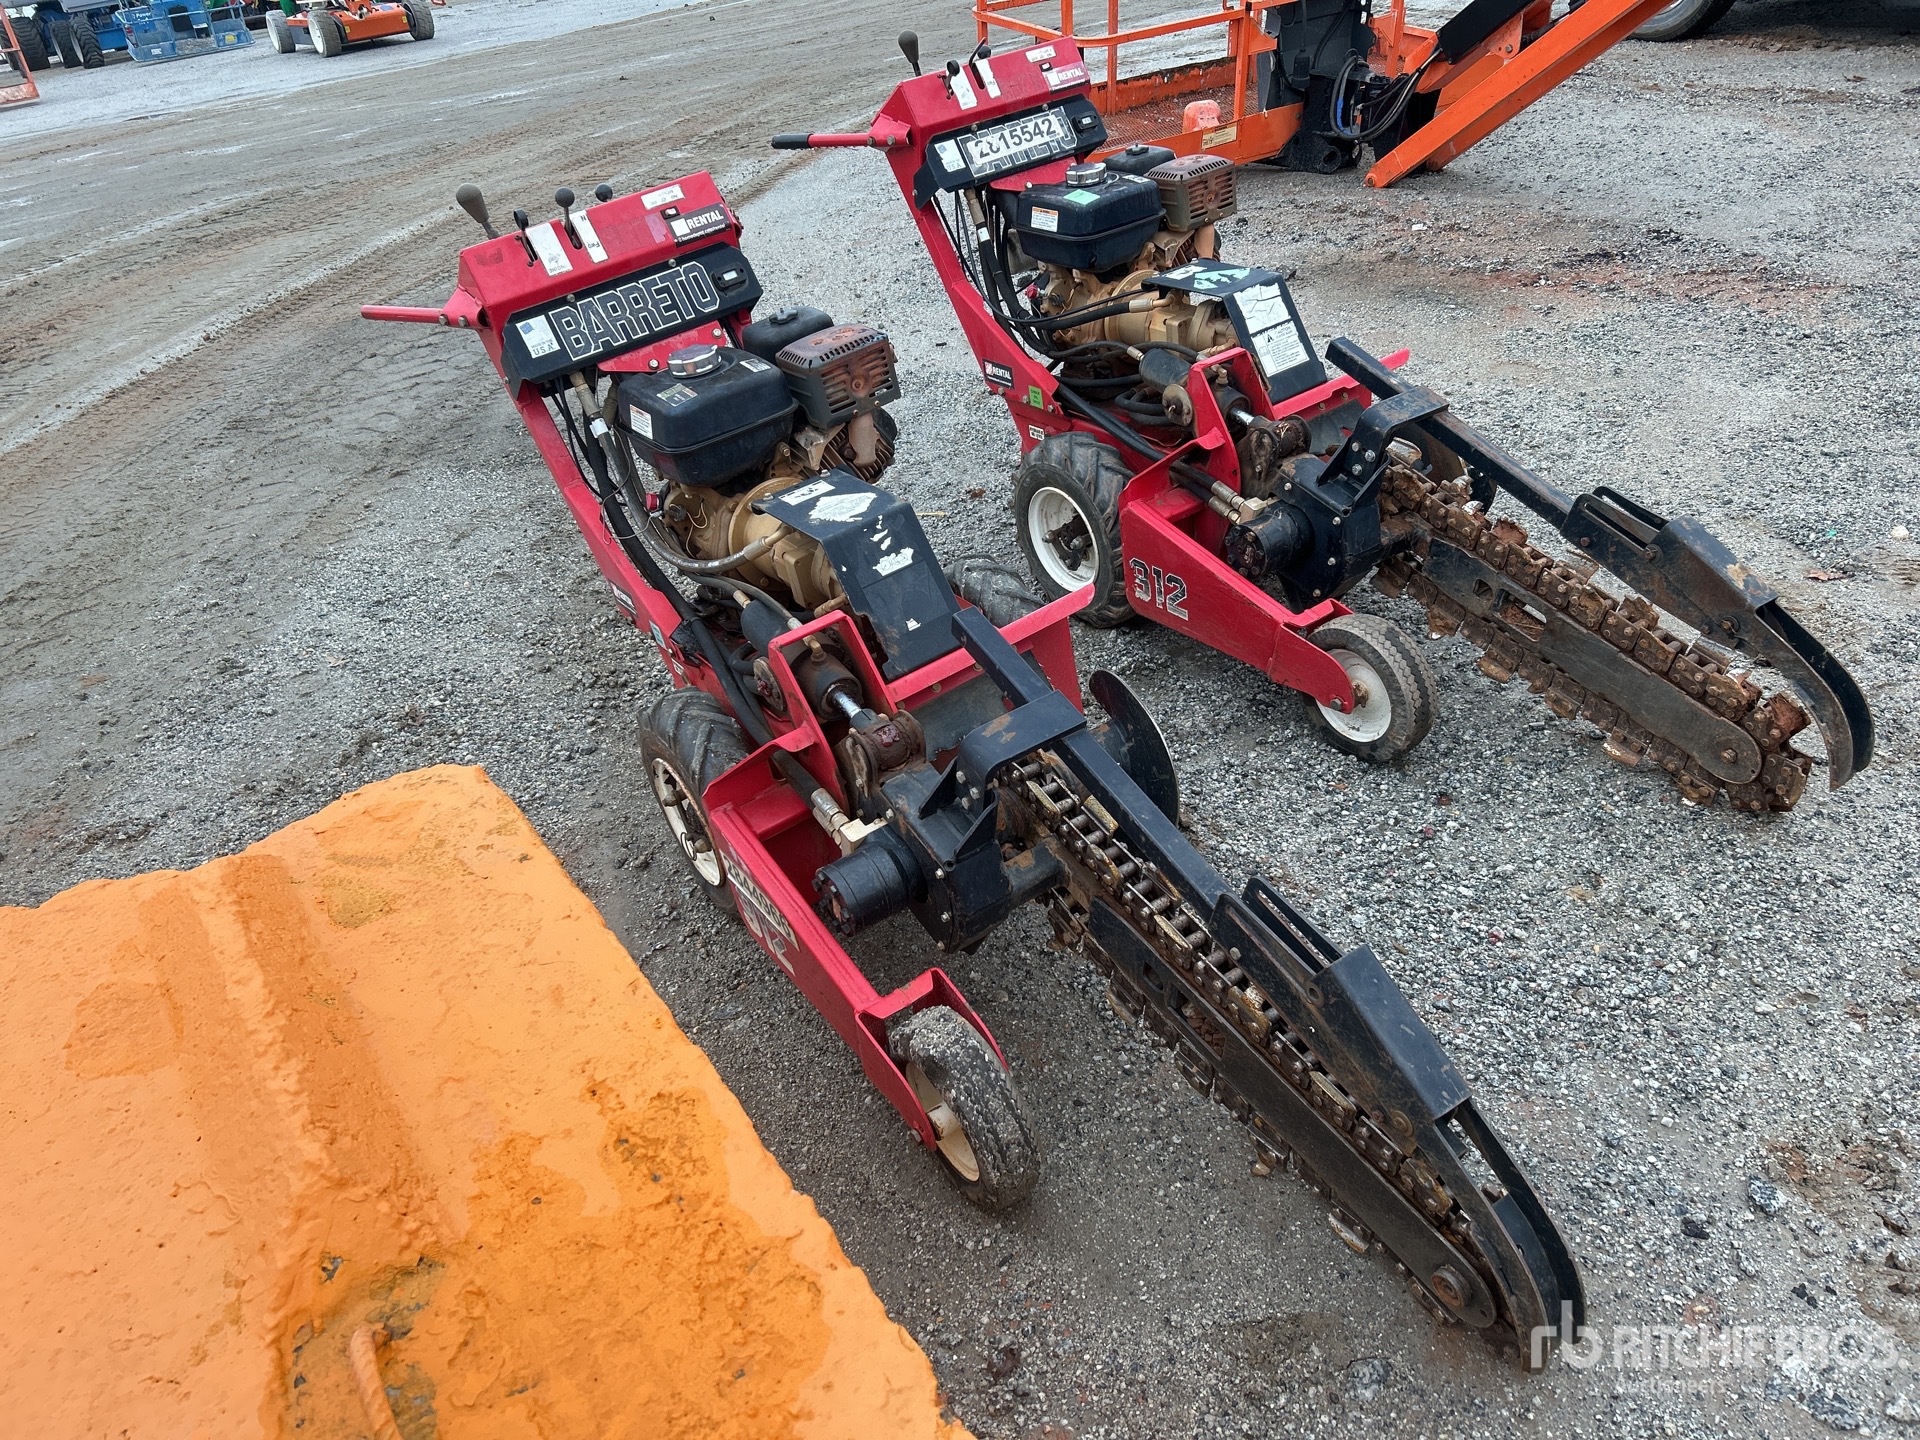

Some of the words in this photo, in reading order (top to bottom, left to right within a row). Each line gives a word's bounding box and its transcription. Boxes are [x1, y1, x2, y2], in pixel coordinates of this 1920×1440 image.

[1058, 68, 1084, 81] RENTAL
[686, 210, 725, 229] RENTAL
[548, 261, 719, 361] BARRETO
[1129, 557, 1189, 621] 312
